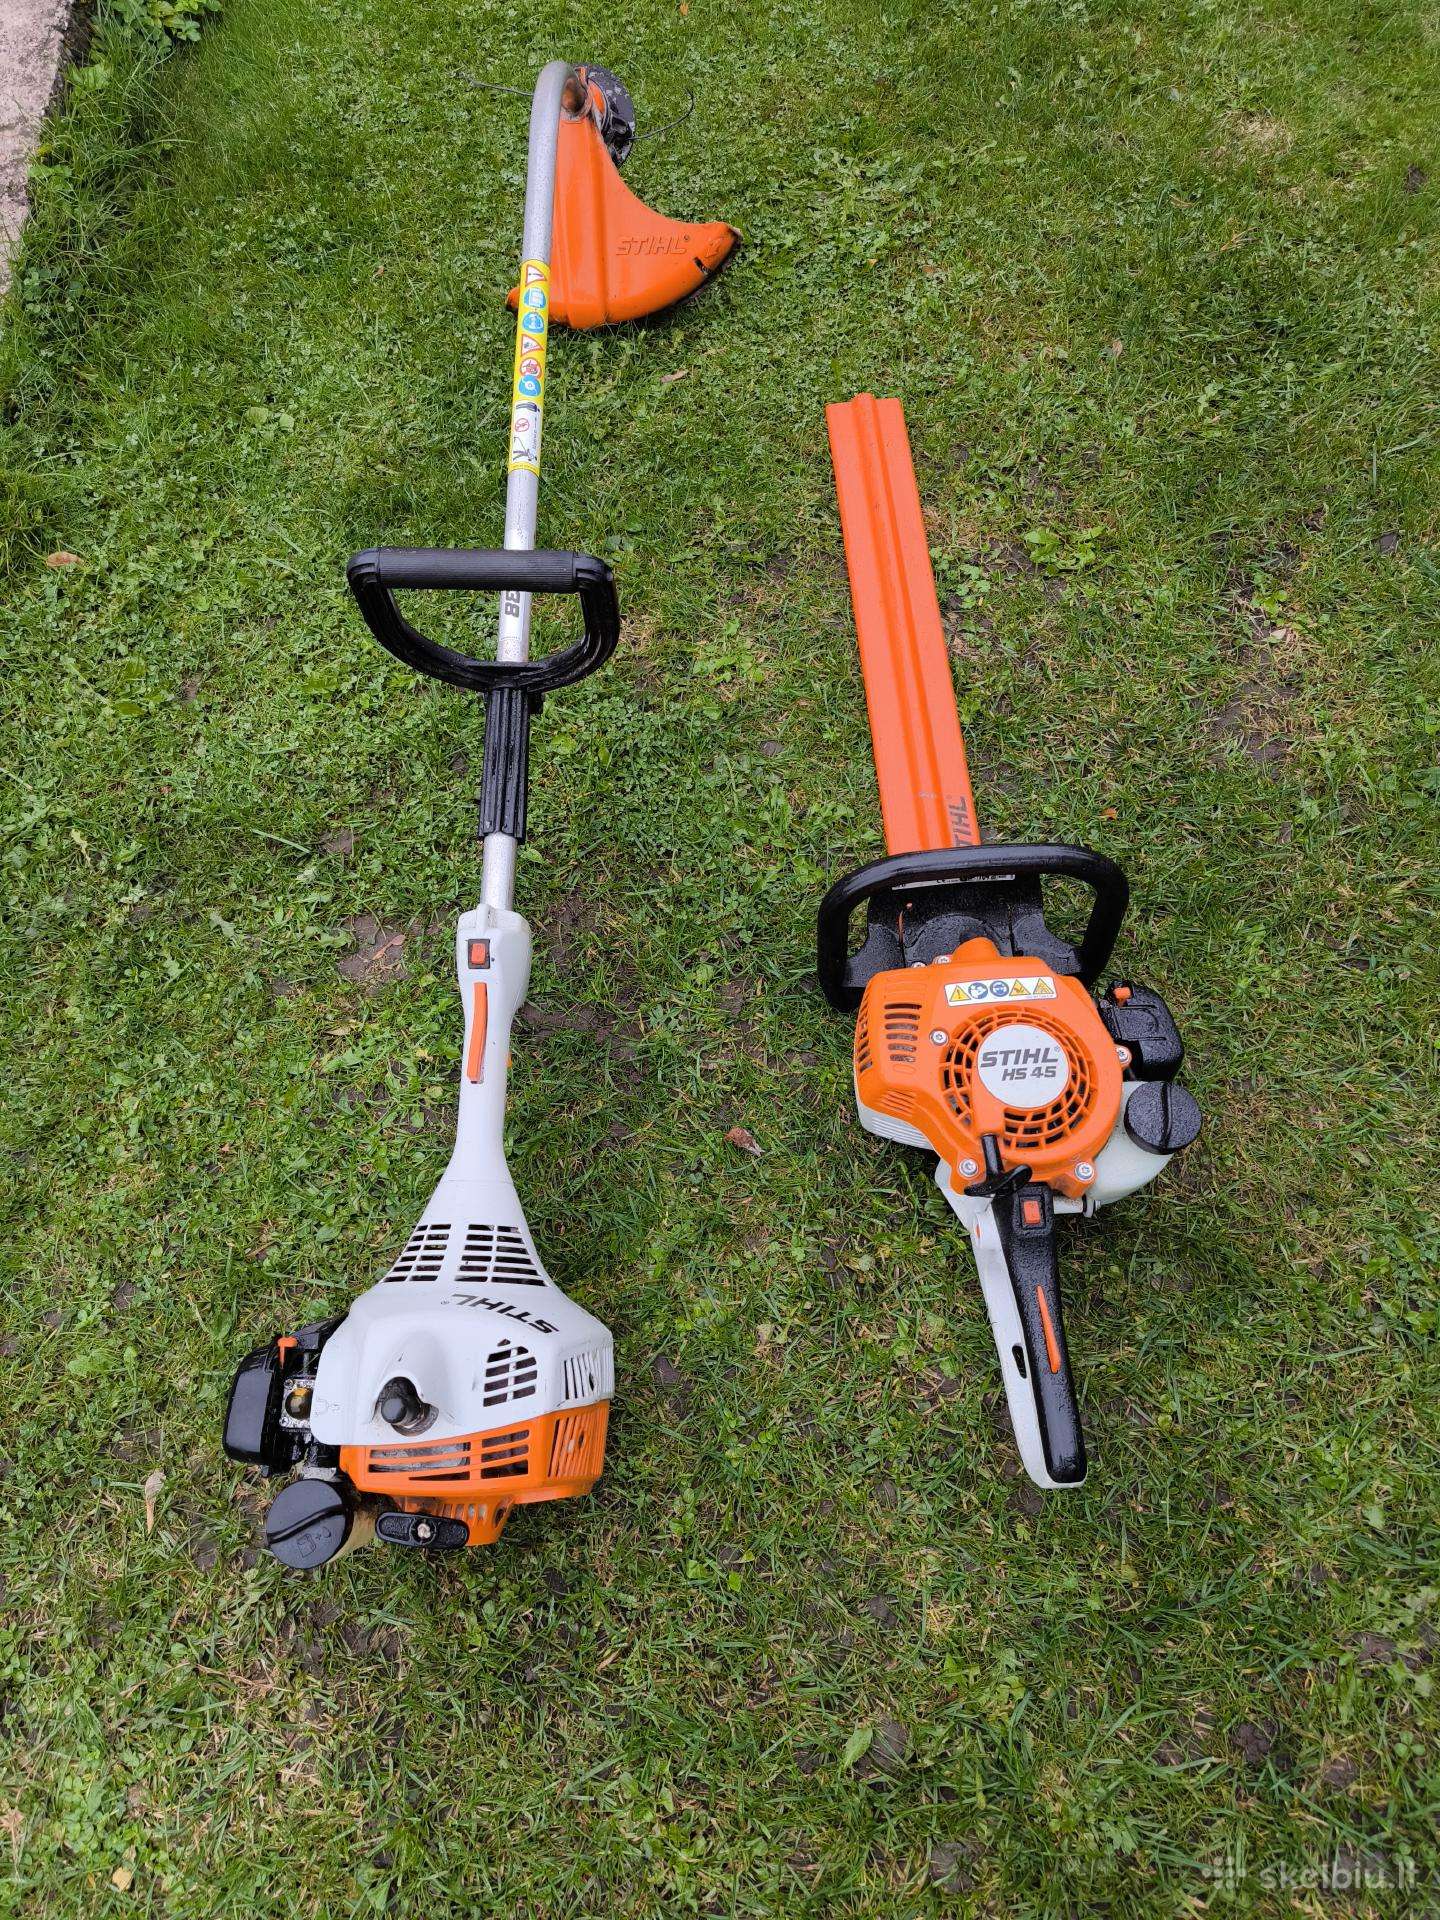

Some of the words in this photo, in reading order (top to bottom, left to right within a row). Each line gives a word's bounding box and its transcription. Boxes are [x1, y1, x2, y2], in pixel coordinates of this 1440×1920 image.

[616, 236, 687, 256] STIHL
[948, 796, 973, 848] TIHL
[980, 1047, 1059, 1070] STIHL
[1001, 1067, 1028, 1082] HS
[1030, 1065, 1057, 1080] 45
[450, 1293, 559, 1334] STIHL
